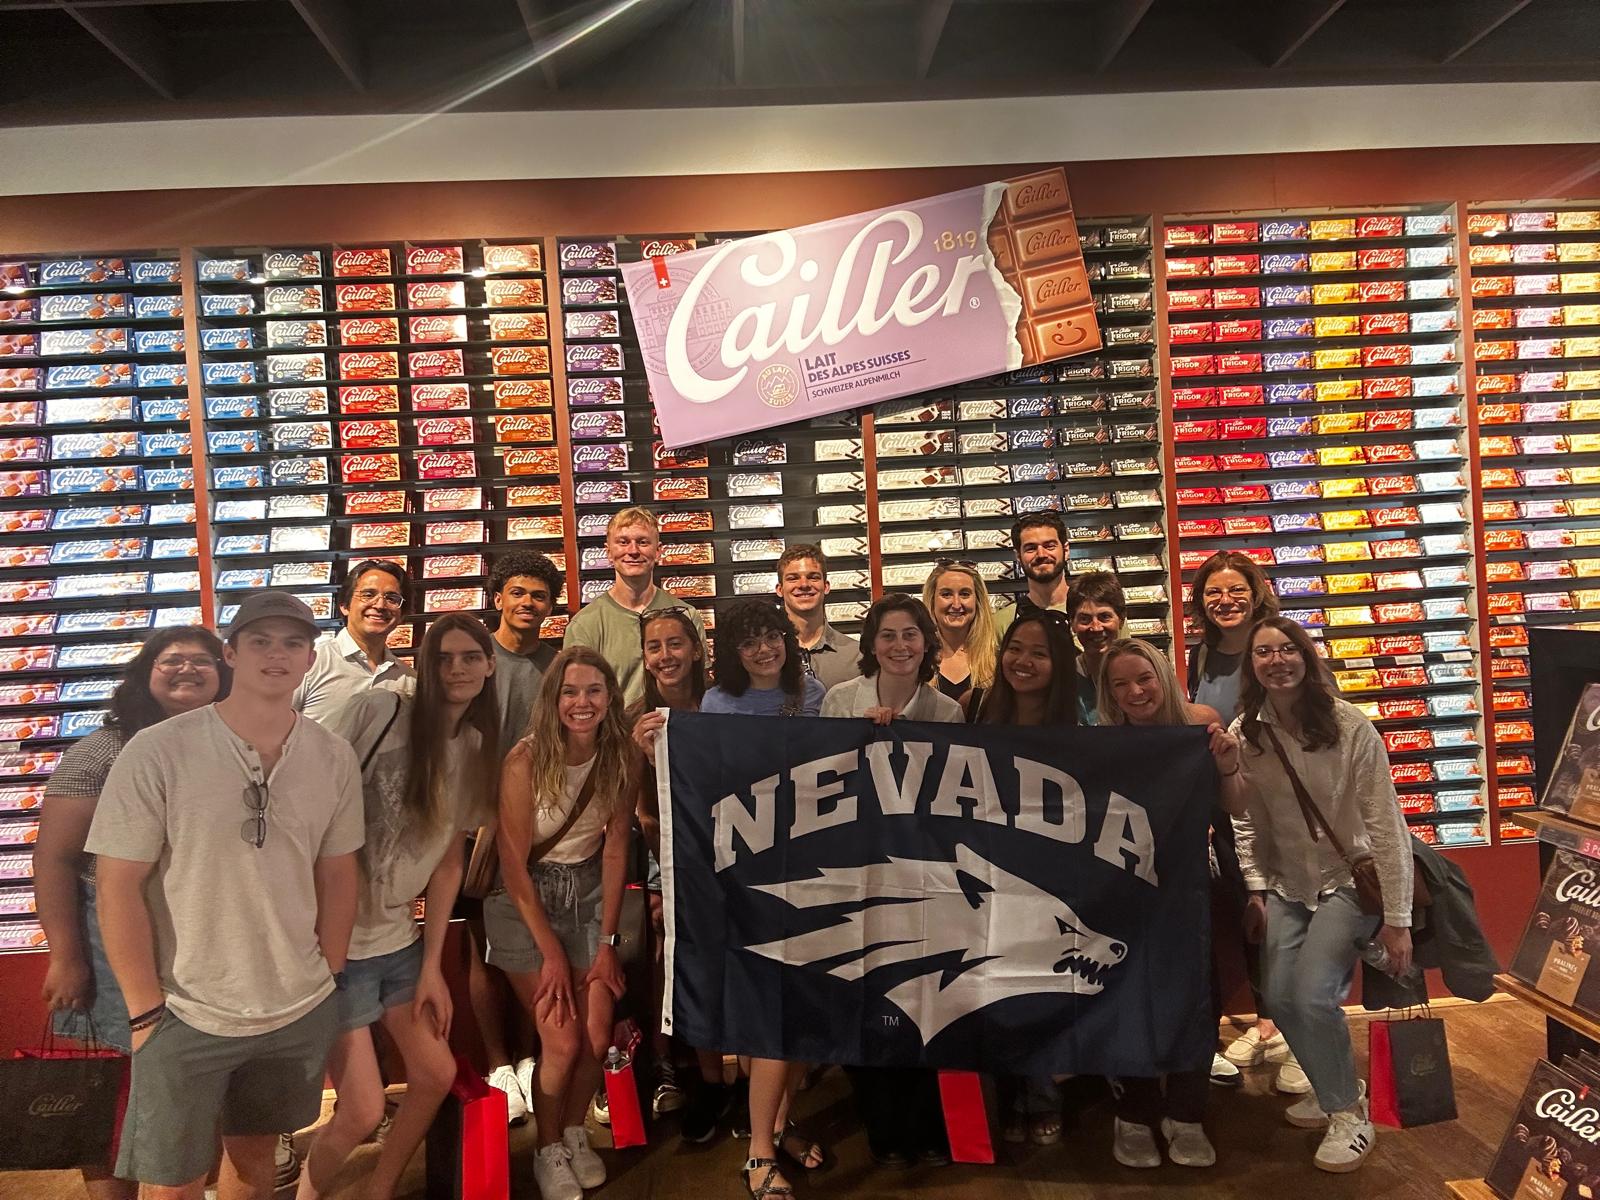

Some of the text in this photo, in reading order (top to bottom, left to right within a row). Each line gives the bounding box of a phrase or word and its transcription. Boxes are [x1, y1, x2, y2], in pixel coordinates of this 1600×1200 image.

[1015, 182, 1060, 209] Cailler
[1362, 218, 1394, 233] Cailler
[1468, 215, 1496, 228] Cailler
[1110, 231, 1137, 242] FRIGOR
[1217, 227, 1244, 238] FRIGOR
[1264, 223, 1295, 237] Cailler
[933, 230, 977, 253] 1819
[1025, 228, 1071, 256] Cailler
[408, 249, 445, 265] Cailler
[561, 244, 599, 261] Cailler
[643, 241, 680, 258] Cailler
[265, 254, 303, 270] Cailler
[336, 252, 374, 268] Cailler
[1265, 255, 1295, 269] Cailler
[1364, 250, 1396, 265] Cailler
[42, 261, 91, 279] Cailler
[136, 262, 174, 278] Cailler
[1111, 264, 1137, 275] FRIGOR
[409, 283, 447, 298] Cailler
[564, 279, 600, 295] Cailler
[1036, 276, 1081, 304] Cailler
[1363, 282, 1395, 298] Cailler
[1472, 278, 1501, 292] Cailler
[267, 288, 305, 303] Cailler
[339, 286, 378, 303] Cailler
[1111, 297, 1138, 307] FRIGOR
[1217, 293, 1245, 303] FRIGOR
[138, 297, 175, 314] Cailler
[665, 210, 986, 403] Cailler
[343, 321, 381, 337] Cailler
[412, 317, 449, 334] Cailler
[491, 316, 529, 332] Cailler
[1220, 325, 1247, 335] FRIGOR
[1269, 320, 1299, 334] Cailler
[1367, 315, 1400, 330] Cailler
[139, 331, 176, 348] Cailler
[204, 330, 241, 345] Cailler
[1111, 330, 1139, 341] FRIGOR
[1170, 328, 1198, 337] FRIGOR
[494, 350, 532, 365] Cailler
[567, 347, 604, 362] Cailler
[1368, 346, 1401, 362] Cailler
[1474, 343, 1504, 357] Cailler
[269, 357, 308, 373] Cailler
[342, 353, 380, 370] Cailler
[411, 352, 446, 370] Cailler
[804, 352, 836, 371] LAIT
[808, 350, 911, 383] DES ALPES SUISSES
[1113, 363, 1140, 373] FRIGOR
[1172, 361, 1199, 370] FRIGOR
[1222, 359, 1248, 368] FRIGOR
[1267, 353, 1297, 368] Cailler
[49, 366, 98, 384] Cailler
[139, 366, 178, 382] Cailler
[207, 365, 243, 380] Cailler
[761, 366, 790, 380] AU LAIT
[496, 382, 534, 399] Cailler
[569, 381, 606, 396] Cailler
[812, 370, 901, 398] SCHWEIZER ALPENMILCH
[1271, 385, 1301, 398] Cailler
[1368, 378, 1401, 394] Cailler
[1477, 378, 1505, 391] Cailler
[271, 389, 310, 407] Cailler
[342, 387, 381, 404] Cailler
[413, 386, 451, 402] Cailler
[768, 394, 795, 406] SUISSE
[1114, 394, 1140, 406] FRIGOR
[1174, 393, 1200, 403] FRIGOR
[1224, 389, 1249, 399] FRIGOR
[145, 400, 182, 418] Cailler
[208, 398, 247, 414] Cailler
[963, 401, 998, 416] Cailler
[1012, 400, 1045, 413] Cailler
[1063, 398, 1092, 408] FRIGOR
[1370, 411, 1402, 427] Cailler
[1479, 406, 1509, 419] Cailler
[419, 419, 456, 436] Cailler
[498, 416, 535, 433] Cailler
[572, 413, 609, 429] Cailler
[1225, 423, 1252, 433] FRIGOR
[275, 424, 314, 441] Cailler
[342, 422, 380, 439] Cailler
[1014, 430, 1048, 444] Cailler
[1066, 430, 1094, 441] FRIGOR
[1117, 428, 1144, 438] FRIGOR
[1175, 425, 1203, 435] FRIGOR
[146, 435, 183, 450] Cailler
[210, 432, 247, 448] Cailler
[964, 434, 998, 450] Cailler
[505, 451, 543, 467] Cailler
[574, 446, 611, 463] Cailler
[1272, 451, 1301, 463] Cailler
[1371, 446, 1403, 458] Cailler
[344, 457, 382, 473] Cailler
[420, 453, 457, 470] Cailler
[1068, 463, 1096, 473] FRIGOR
[1118, 460, 1145, 470] FRIGOR
[1225, 456, 1252, 465] FRIGOR
[272, 460, 311, 477] Cailler
[966, 466, 1000, 481] Cailler
[1015, 464, 1048, 478] Cailler
[53, 468, 102, 489] Cailler
[148, 470, 185, 486] Cailler
[215, 469, 252, 484] Cailler
[729, 474, 764, 489] Cailler
[1372, 477, 1404, 491] Cailler
[509, 487, 546, 498] Cailler
[576, 482, 614, 495] Cailler
[656, 478, 691, 492] Cailler
[348, 492, 387, 505] Cailler
[1018, 497, 1051, 509] Cailler
[1070, 496, 1097, 505] FRIGOR
[731, 505, 765, 520] Cailler
[969, 500, 1000, 516] Cailler
[1376, 509, 1409, 522] Cailler
[578, 516, 610, 528] Caille
[659, 513, 695, 525] Cailler
[354, 525, 390, 538] Cailler
[1070, 529, 1098, 539] FRIGOR
[1121, 526, 1148, 535] FRIGOR
[663, 577, 699, 591] Cailler
[1279, 578, 1309, 590] Cailler
[1389, 732, 1422, 745] Cailler
[711, 741, 1158, 887] NEVADA
[1584, 842, 1590, 852] 3
[882, 1015, 900, 1027] TM
[28, 1093, 84, 1118] Cailler
